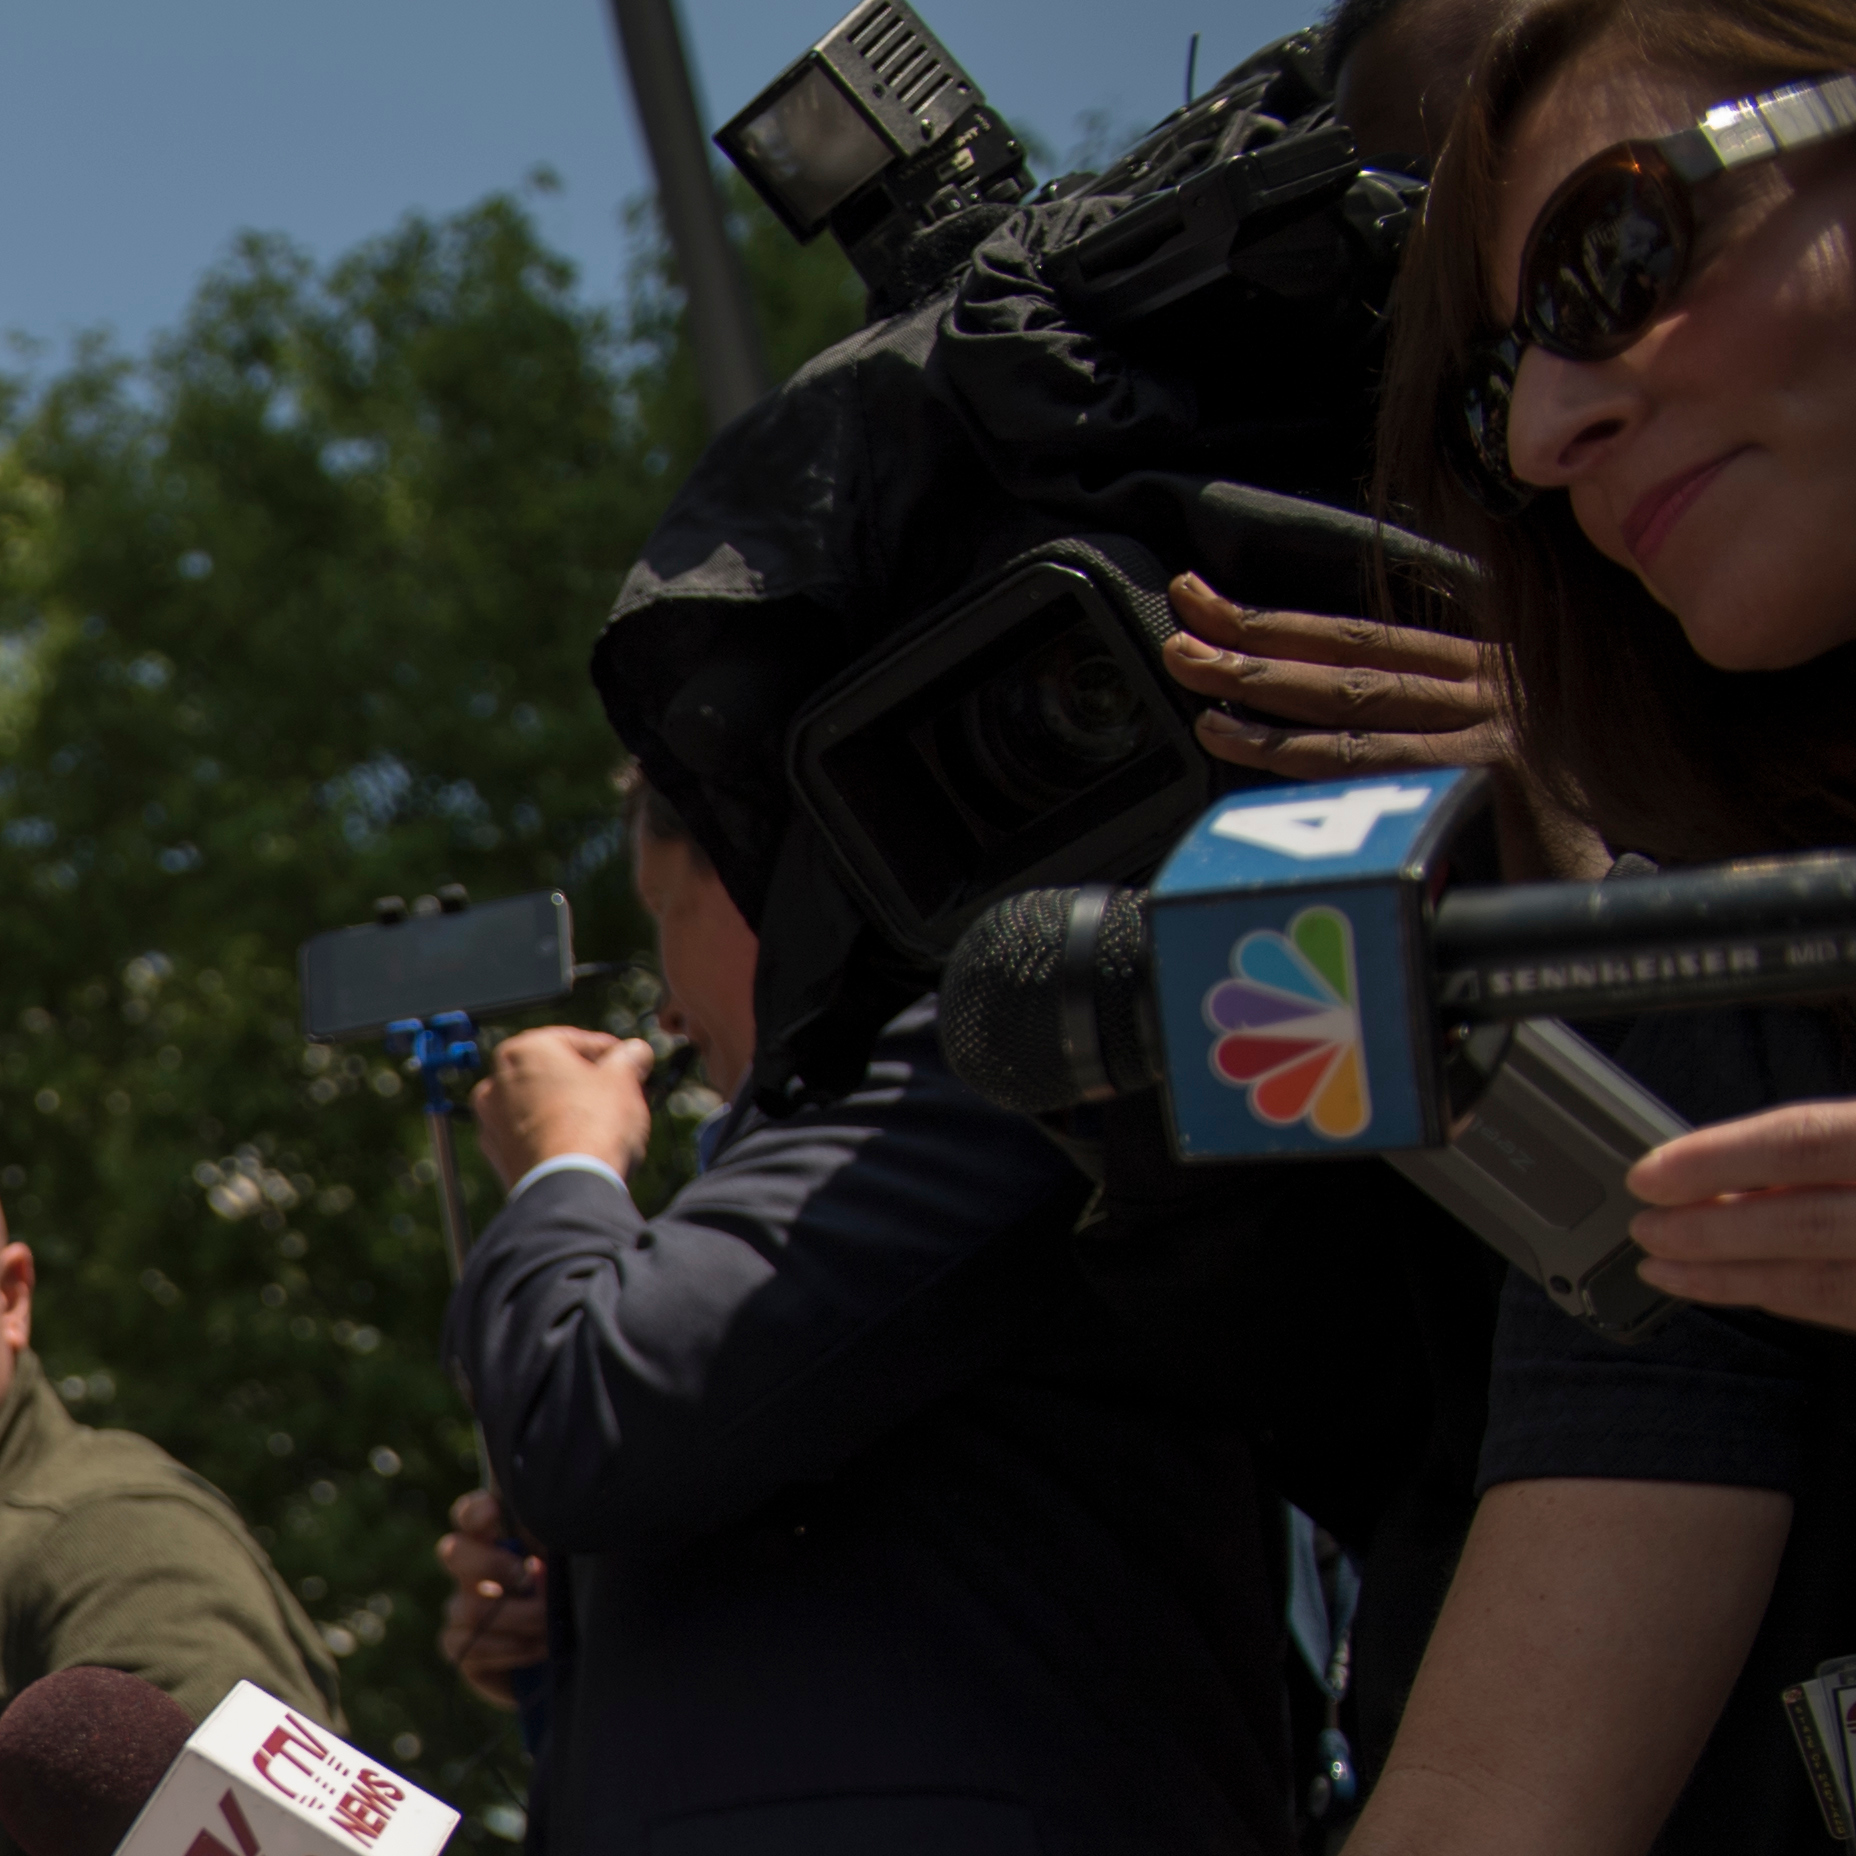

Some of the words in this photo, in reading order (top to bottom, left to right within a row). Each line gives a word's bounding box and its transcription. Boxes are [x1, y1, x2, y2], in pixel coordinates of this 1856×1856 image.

[1210, 784, 1434, 860] 4
[1490, 946, 1761, 995] SENNHEISER
[252, 1711, 350, 1811] CTV
[329, 1767, 406, 1849] NEWS
